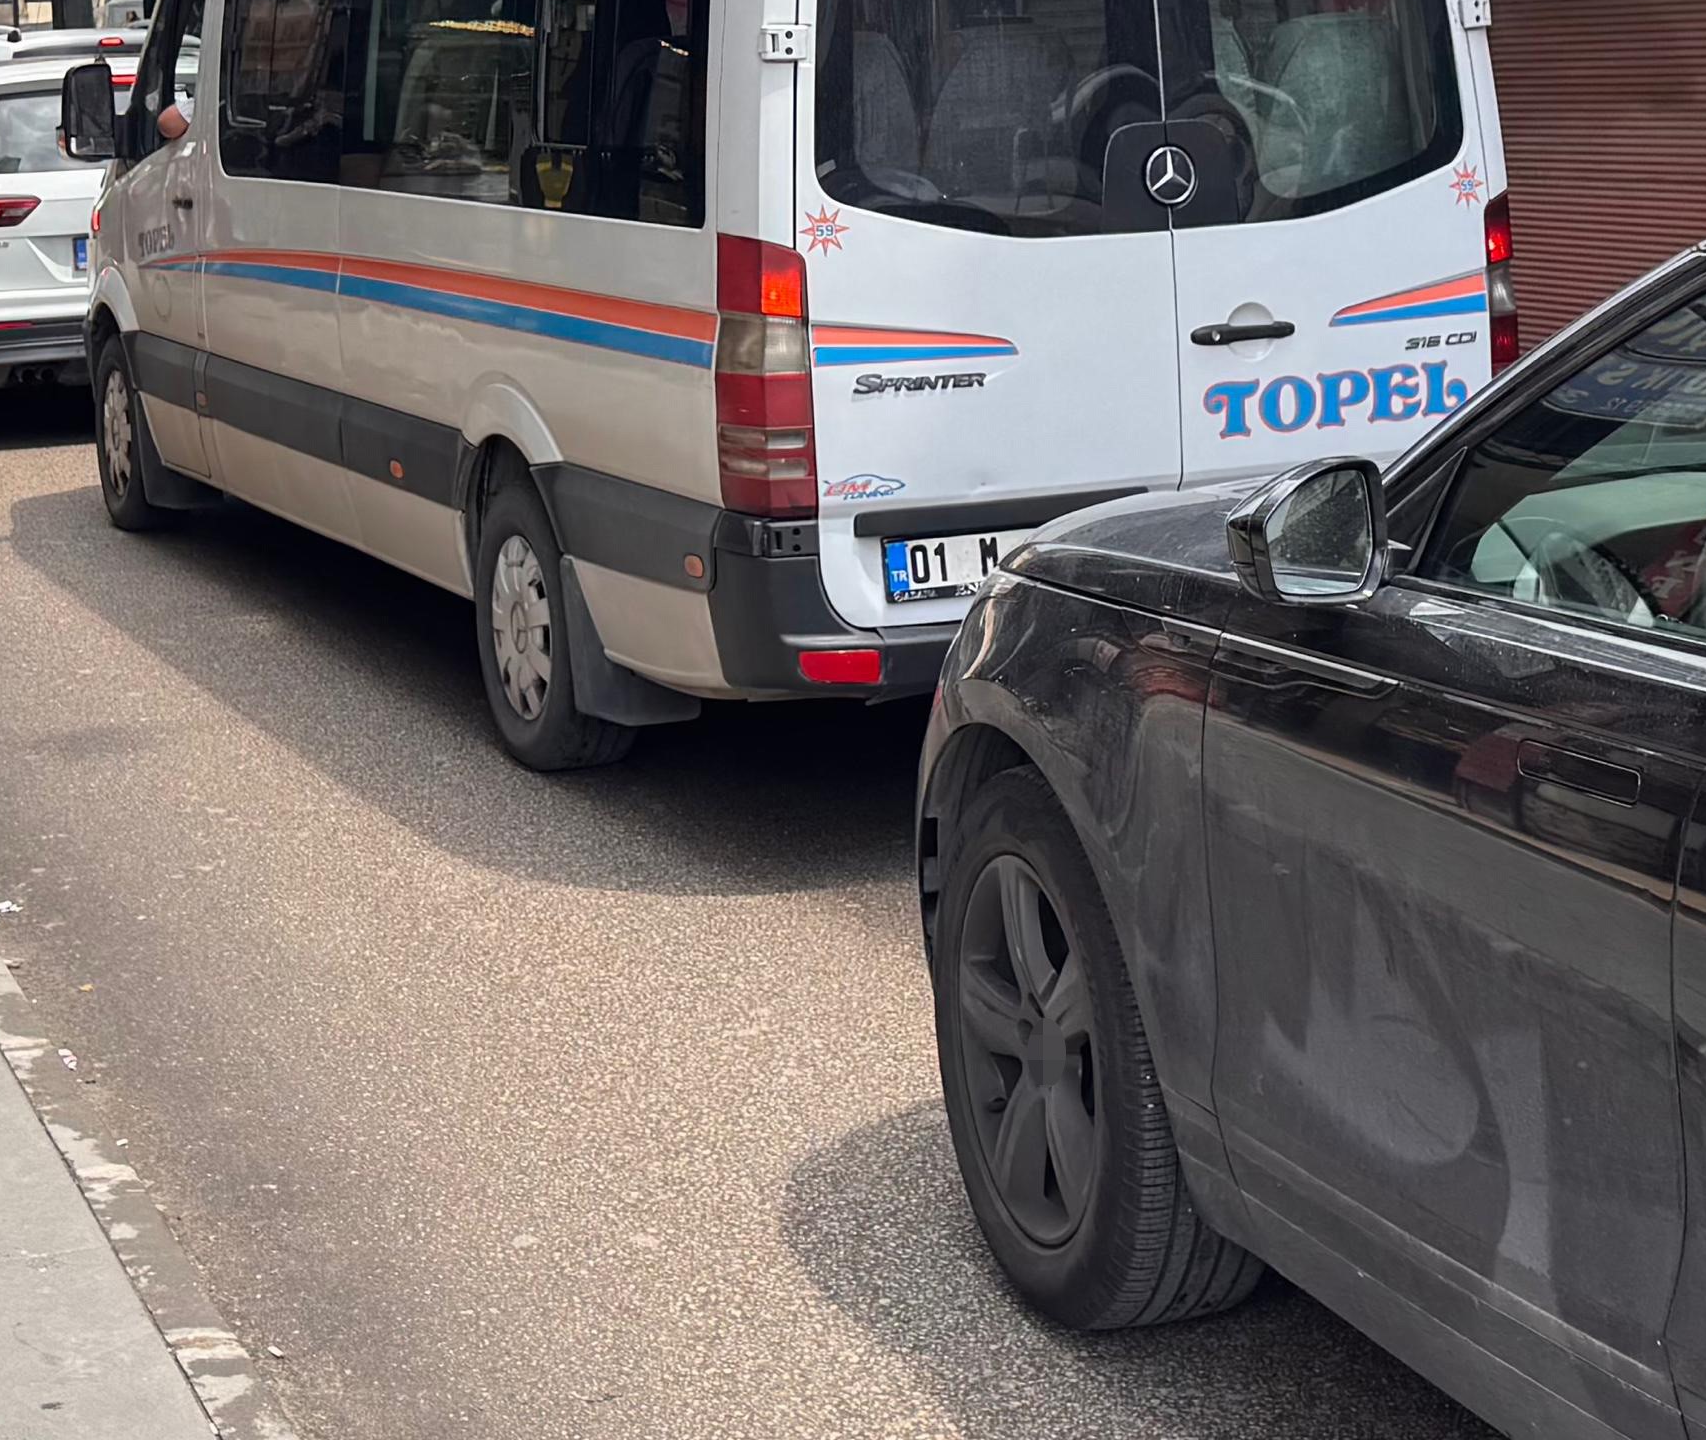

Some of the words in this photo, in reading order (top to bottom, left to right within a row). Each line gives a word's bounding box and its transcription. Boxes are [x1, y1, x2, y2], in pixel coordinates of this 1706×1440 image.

[814, 223, 836, 240] 59
[1446, 331, 1477, 347] CDI
[1203, 360, 1469, 440] TOPEL
[910, 542, 949, 585] 01
